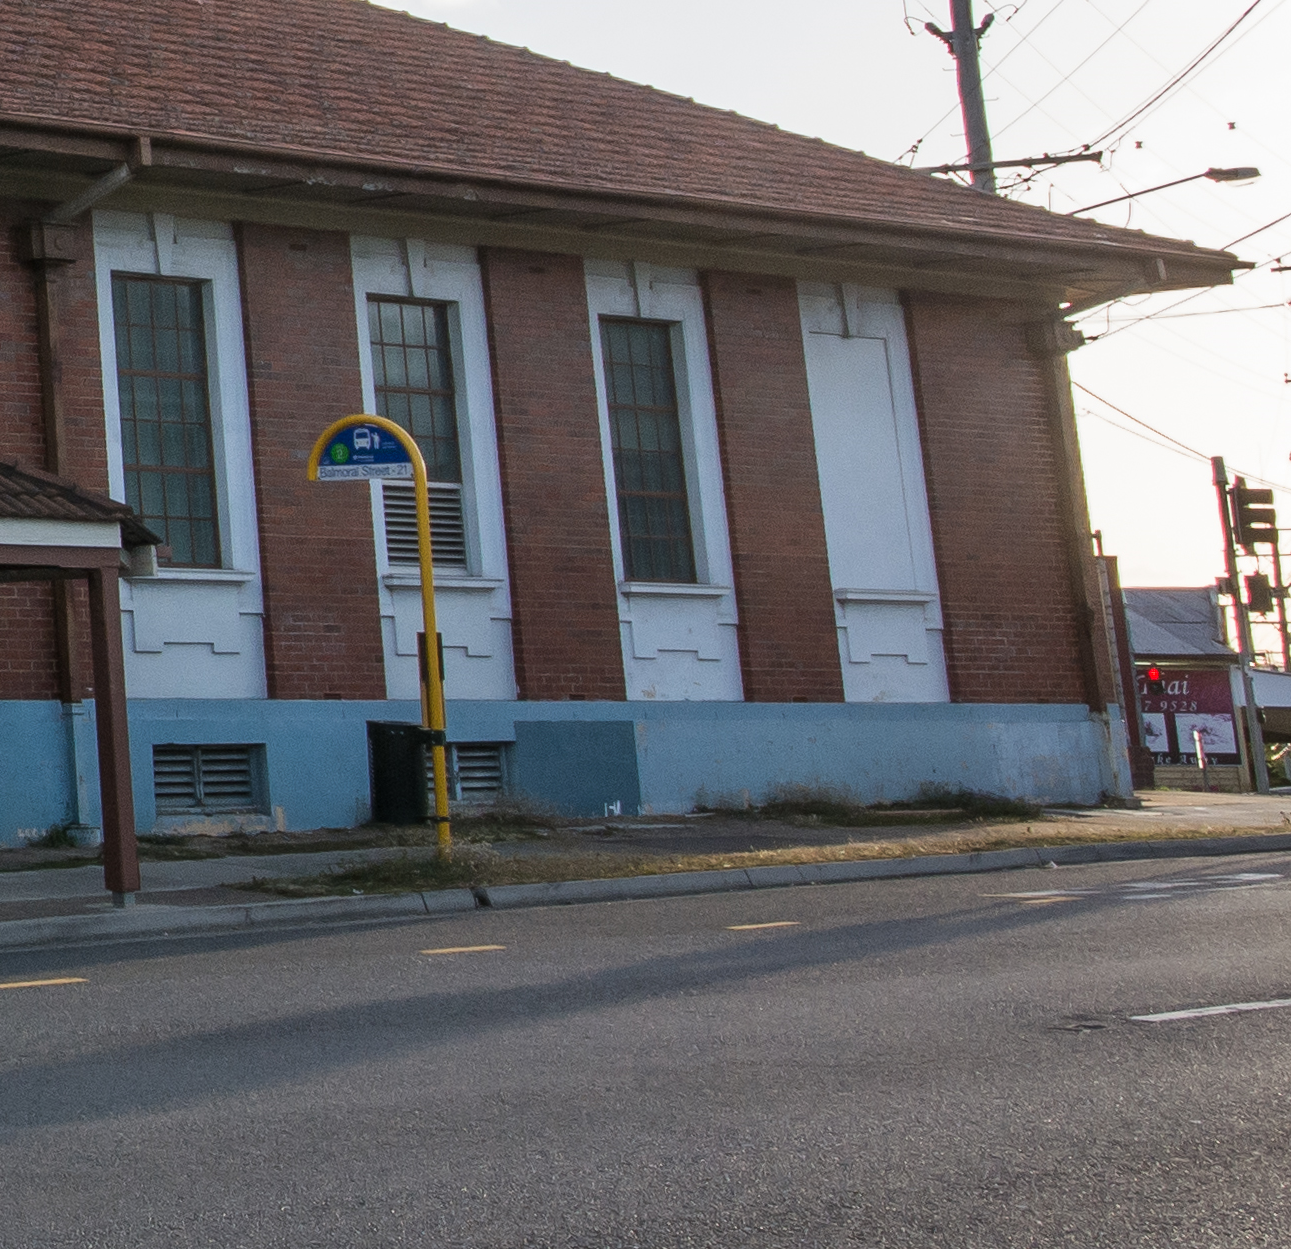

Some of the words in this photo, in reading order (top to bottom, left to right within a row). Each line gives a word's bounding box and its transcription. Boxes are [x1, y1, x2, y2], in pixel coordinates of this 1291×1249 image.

[319, 466, 359, 478] Balmoral
[361, 465, 390, 476] Street
[397, 464, 408, 475] 21
[1160, 700, 1198, 712] 9528
